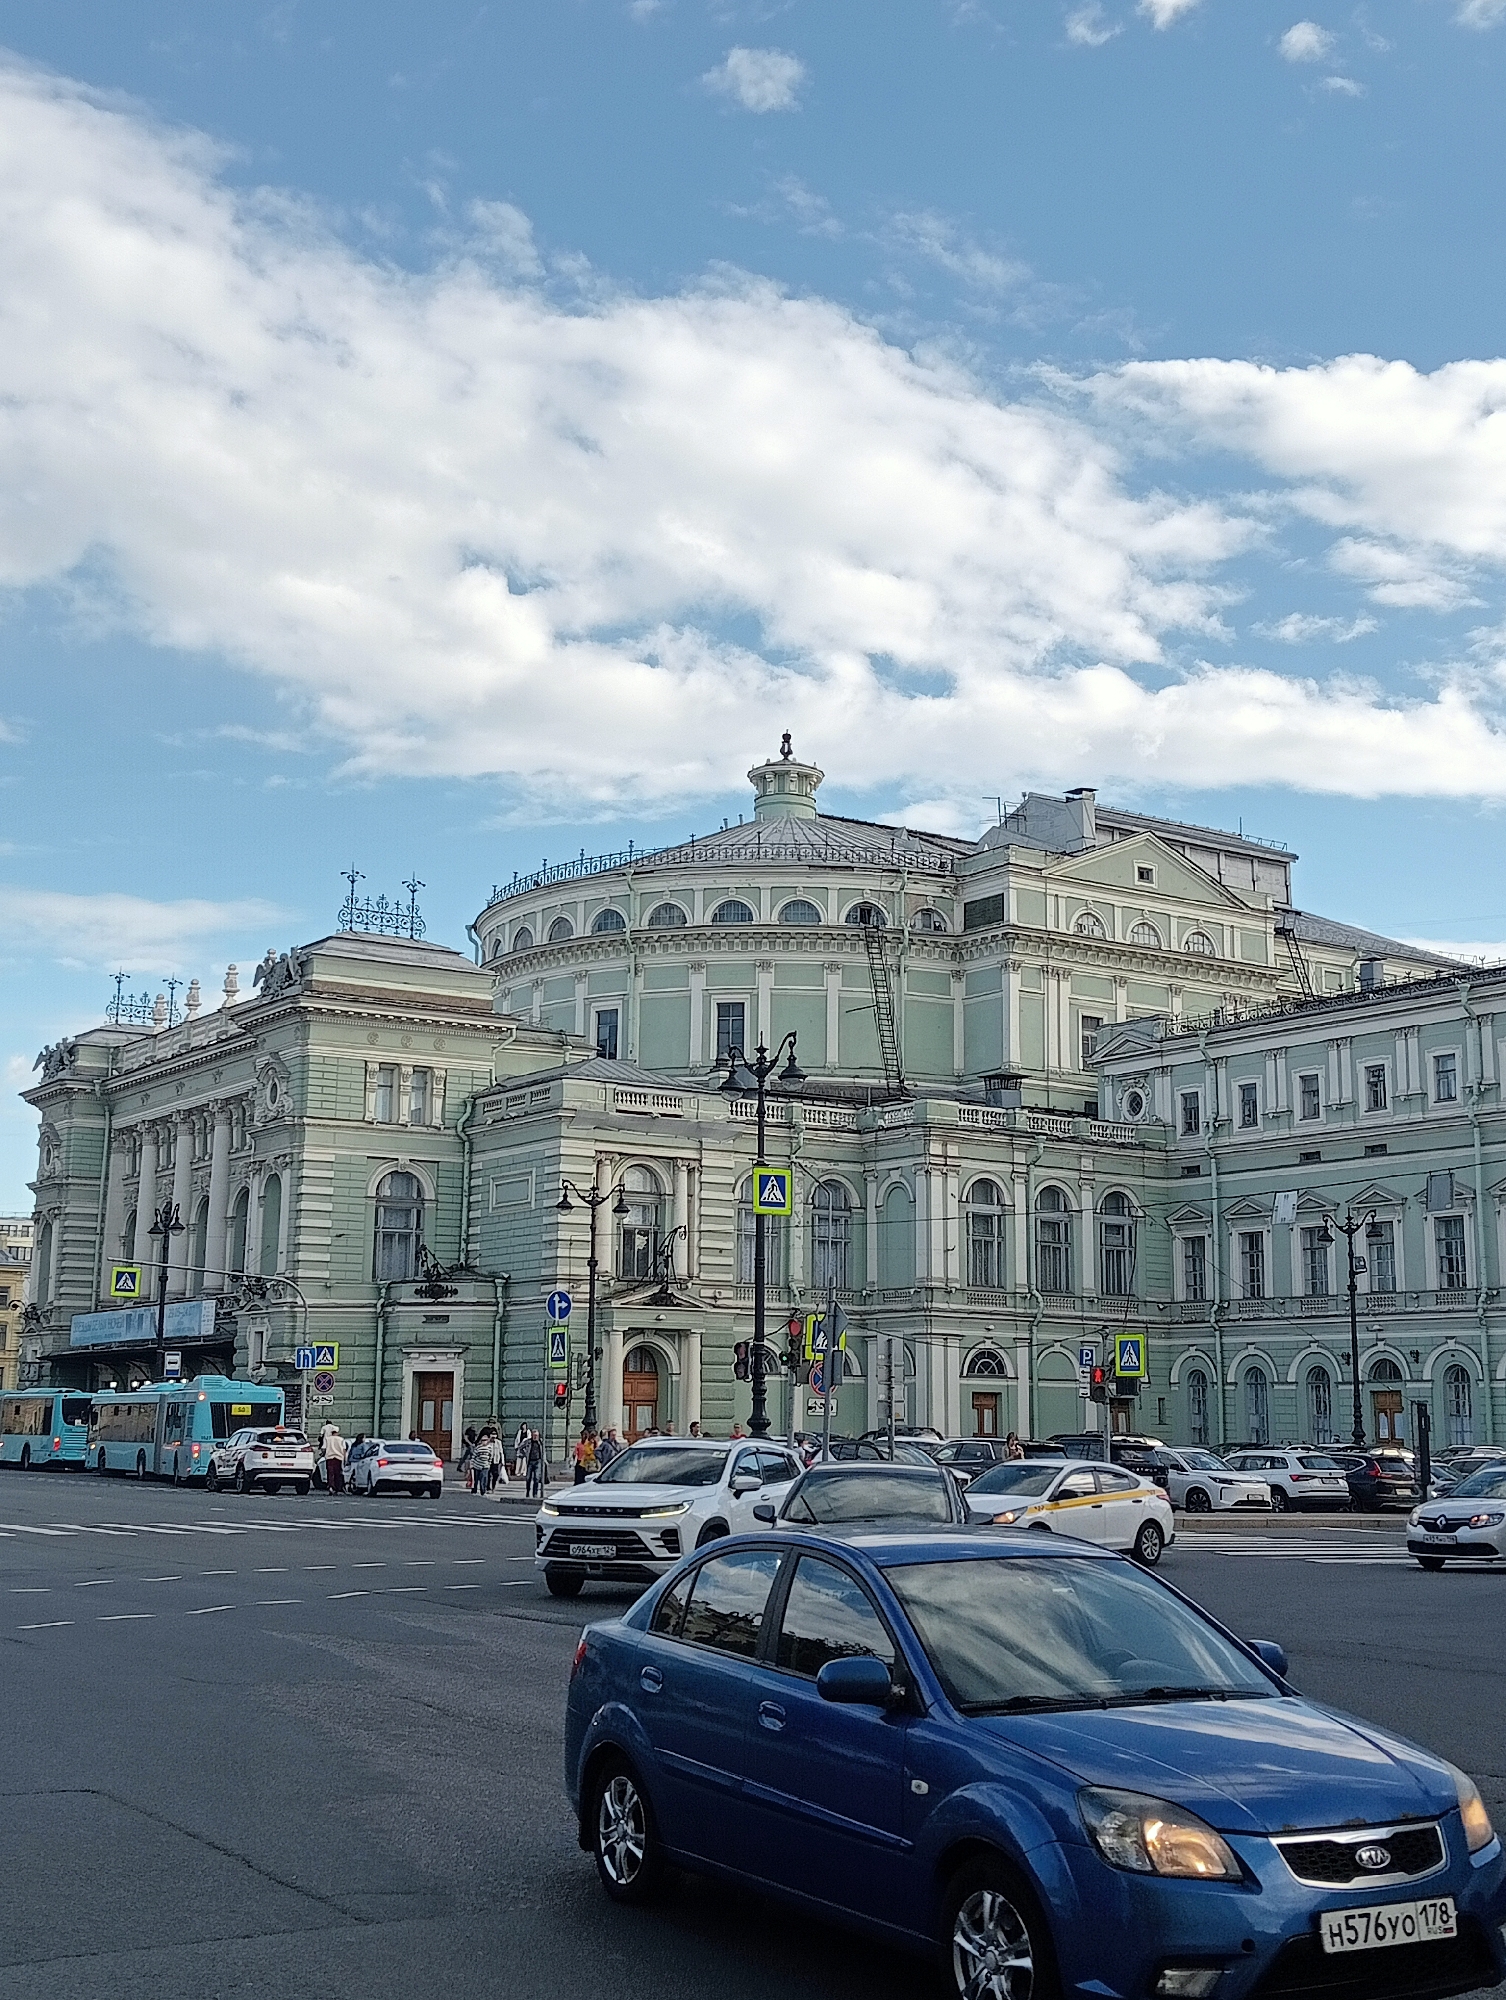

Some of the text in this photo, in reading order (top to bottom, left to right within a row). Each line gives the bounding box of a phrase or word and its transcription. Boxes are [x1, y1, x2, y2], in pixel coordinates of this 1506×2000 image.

[1083, 1350, 1091, 1364] P
[1359, 1848, 1389, 1865] KIA
[1419, 1902, 1450, 1927] 178
[1427, 1926, 1443, 1935] RUS
